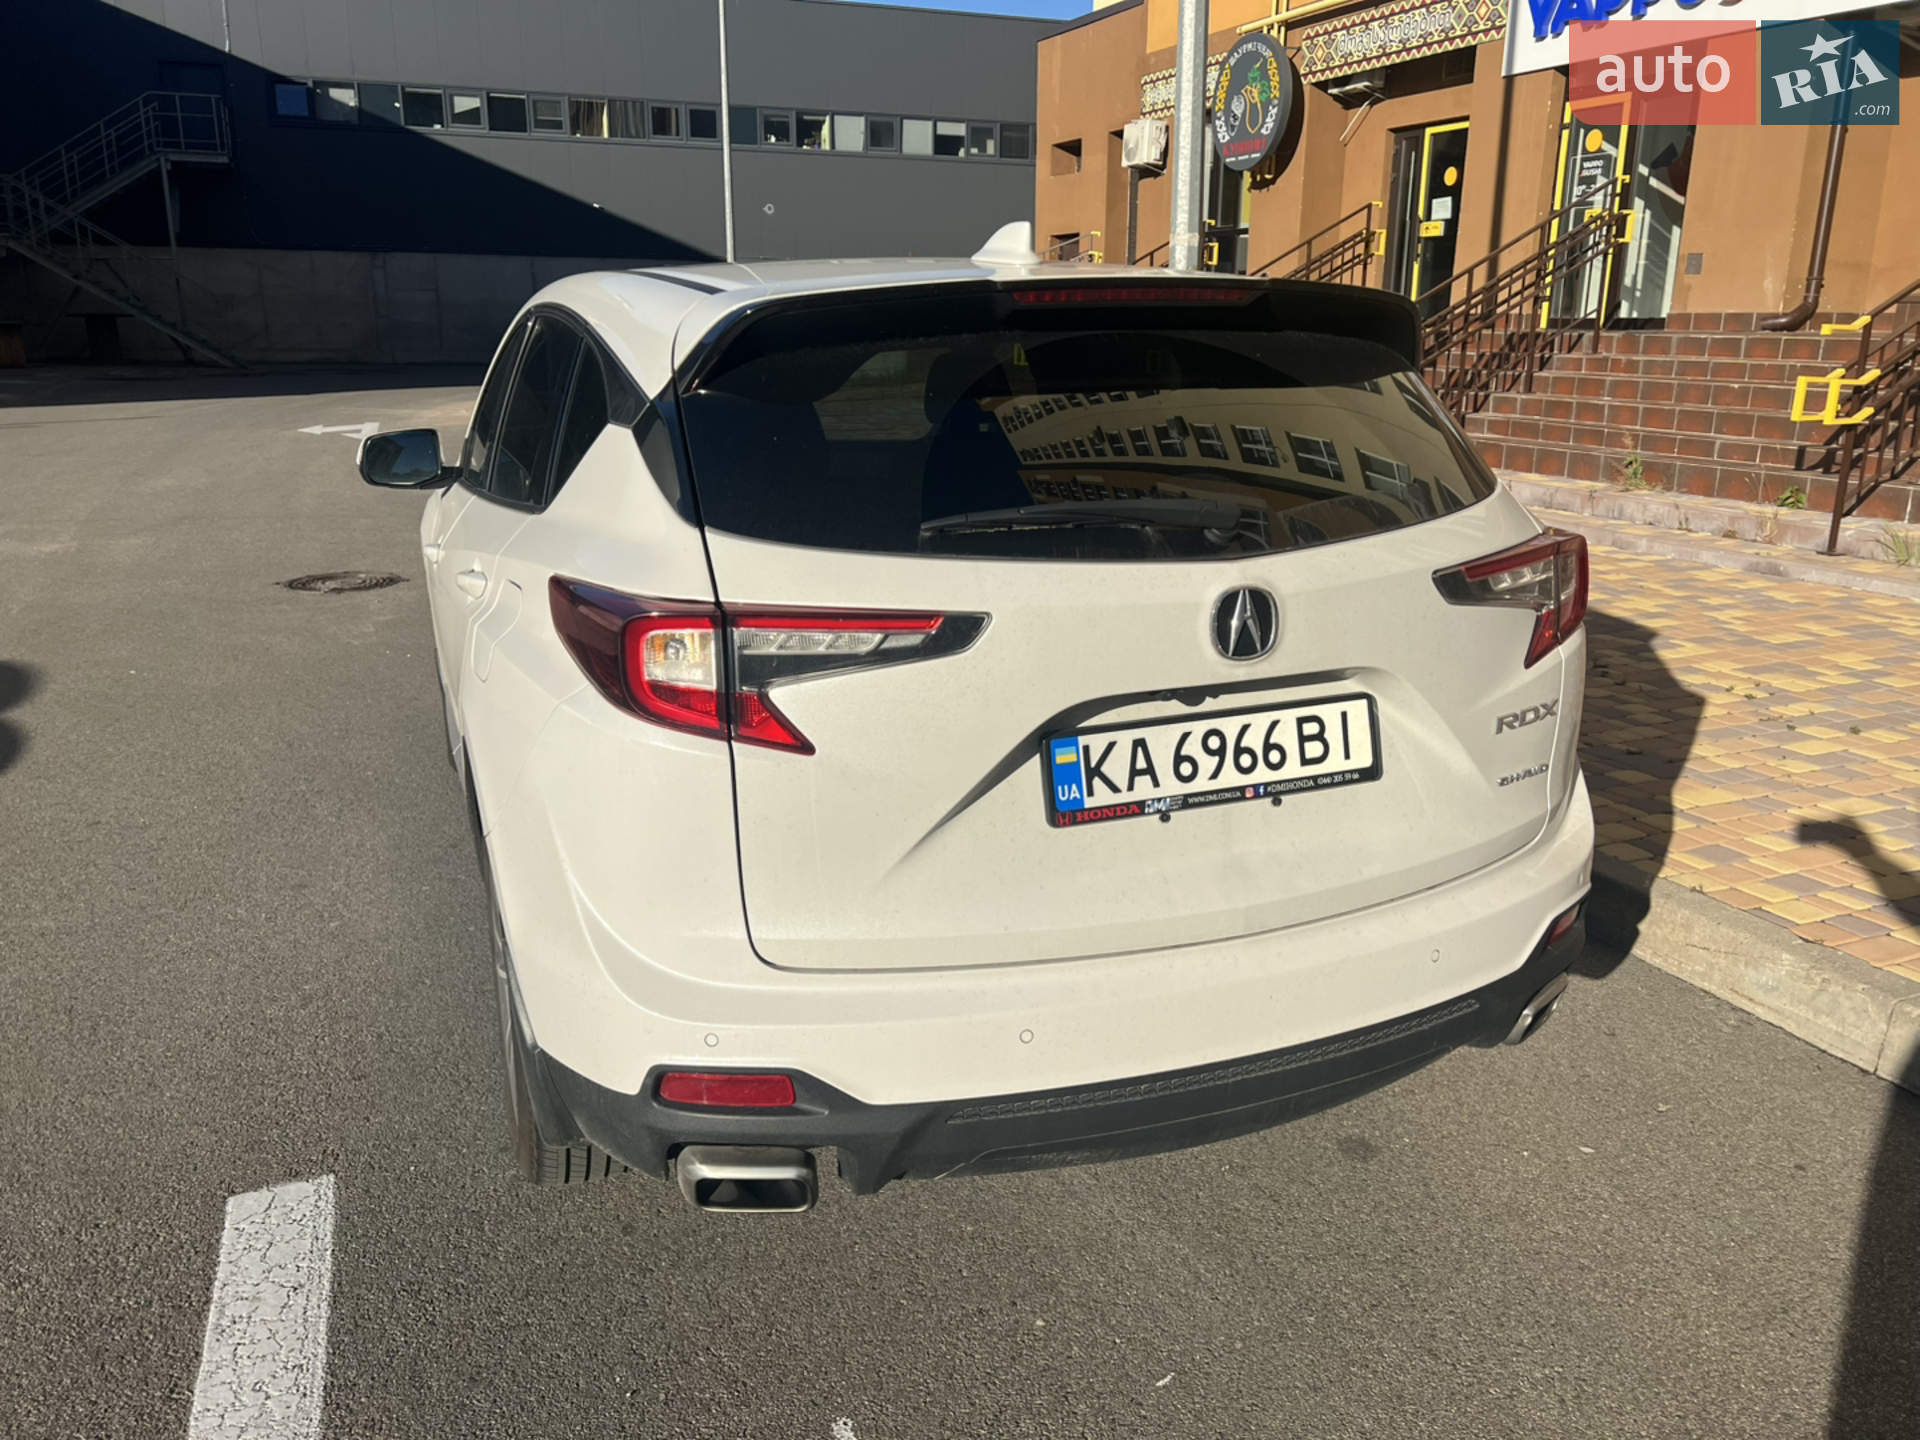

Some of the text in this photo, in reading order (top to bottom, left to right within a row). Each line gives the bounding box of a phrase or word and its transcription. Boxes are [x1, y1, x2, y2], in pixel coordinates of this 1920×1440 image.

[1527, 0, 1706, 42] YAP
[1496, 699, 1559, 735] RDX
[1083, 711, 1351, 797] KA 6966 BI
[1058, 783, 1081, 801] UA
[1076, 803, 1141, 823] HONDA
